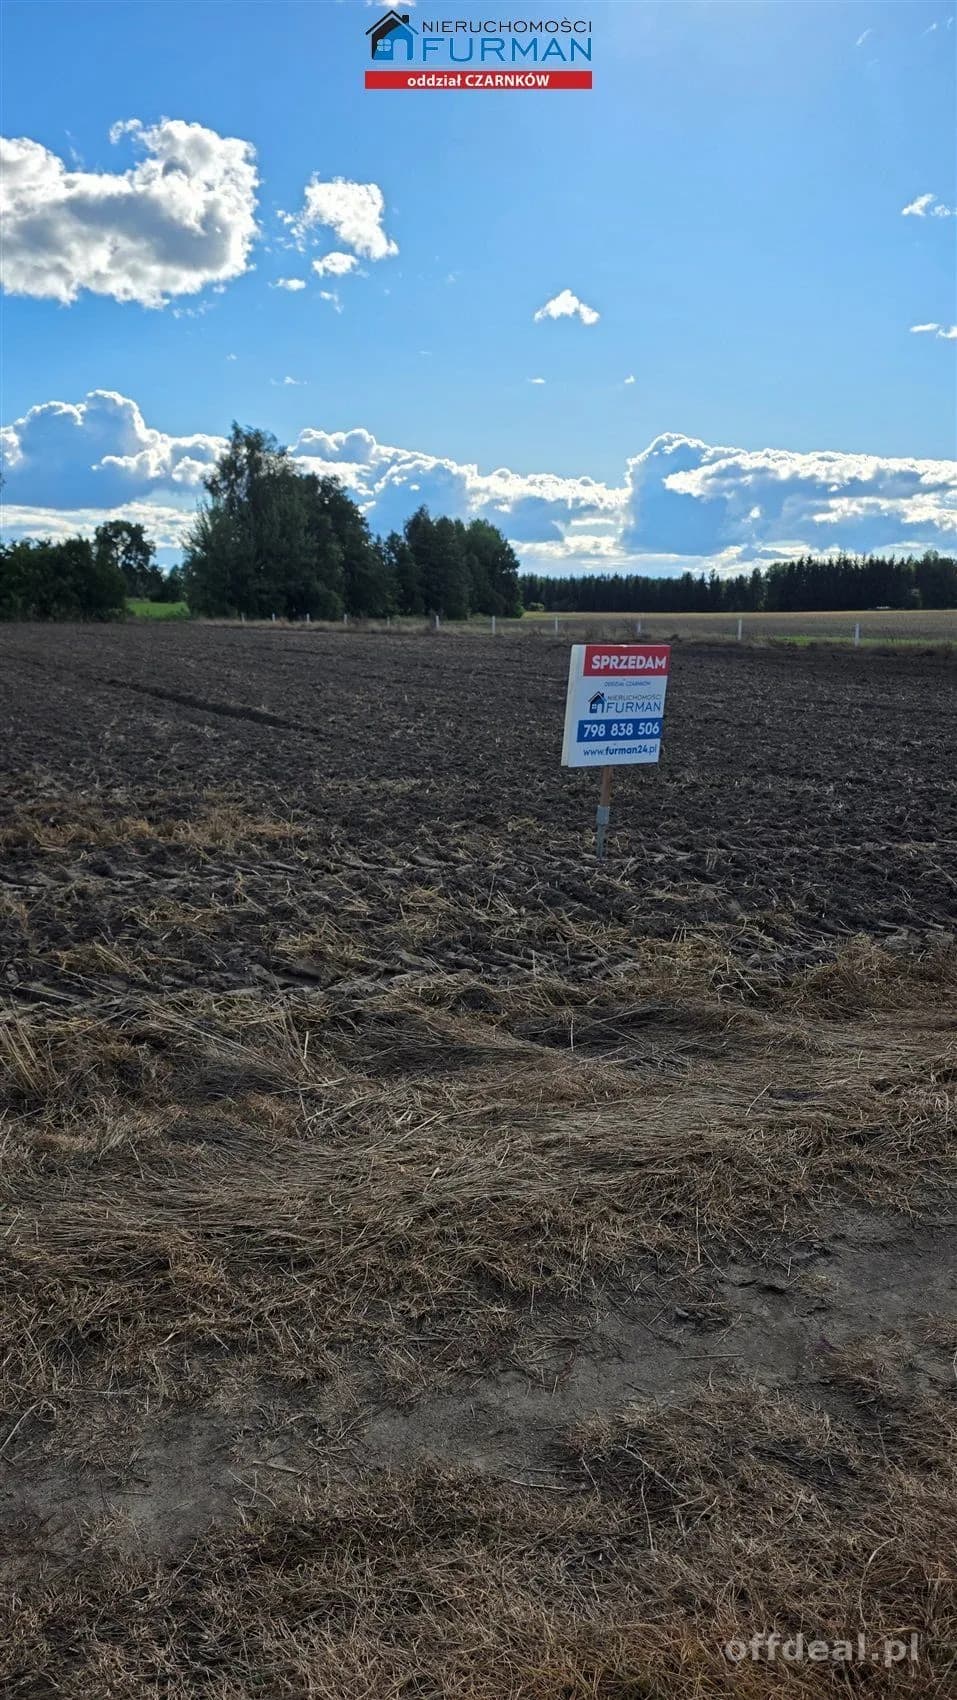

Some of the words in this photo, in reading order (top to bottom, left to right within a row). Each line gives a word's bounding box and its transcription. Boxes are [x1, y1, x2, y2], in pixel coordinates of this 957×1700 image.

[591, 656, 666, 669] SPRZEDAM
[606, 701, 661, 713] FURMAN
[583, 724, 606, 738] 798
[610, 723, 633, 736] 838
[637, 722, 660, 735] 506
[583, 744, 657, 756] www.furman24.pl
